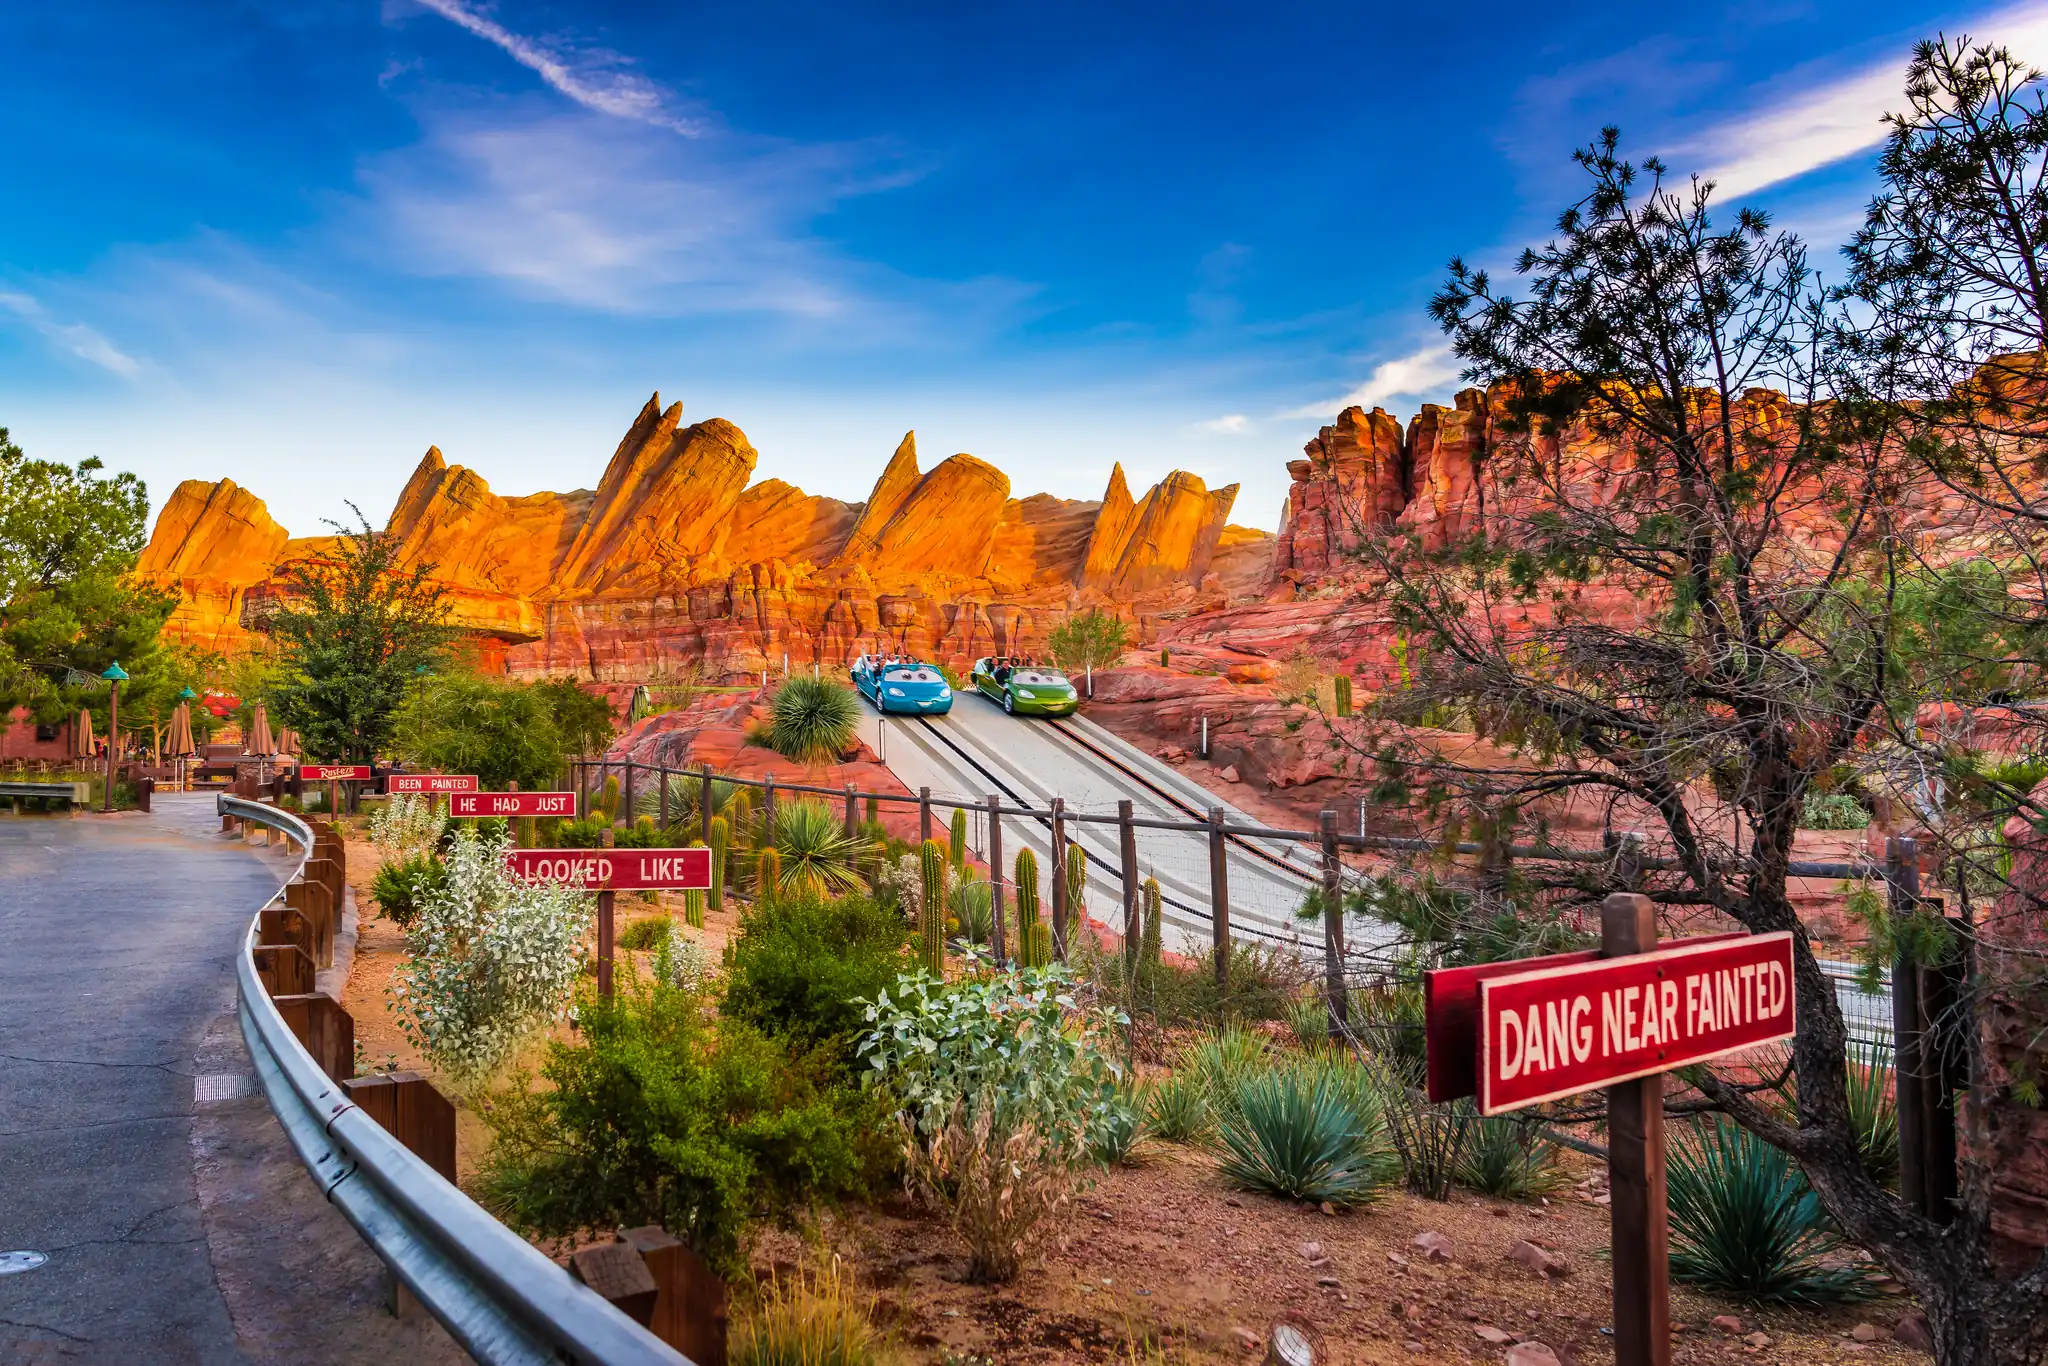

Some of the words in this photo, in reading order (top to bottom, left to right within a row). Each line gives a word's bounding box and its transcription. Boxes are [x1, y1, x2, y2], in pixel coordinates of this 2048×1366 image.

[398, 778, 422, 790] BEEN
[431, 778, 469, 790] PAINTED
[460, 798, 477, 812] HE
[493, 797, 520, 812] HAD
[536, 797, 566, 812] JUST
[524, 858, 613, 882] LOOKED
[640, 857, 685, 881] LIKE
[1499, 994, 1593, 1081] DANG
[1601, 979, 1679, 1057] NEAR
[1685, 960, 1786, 1038] FAINTED
